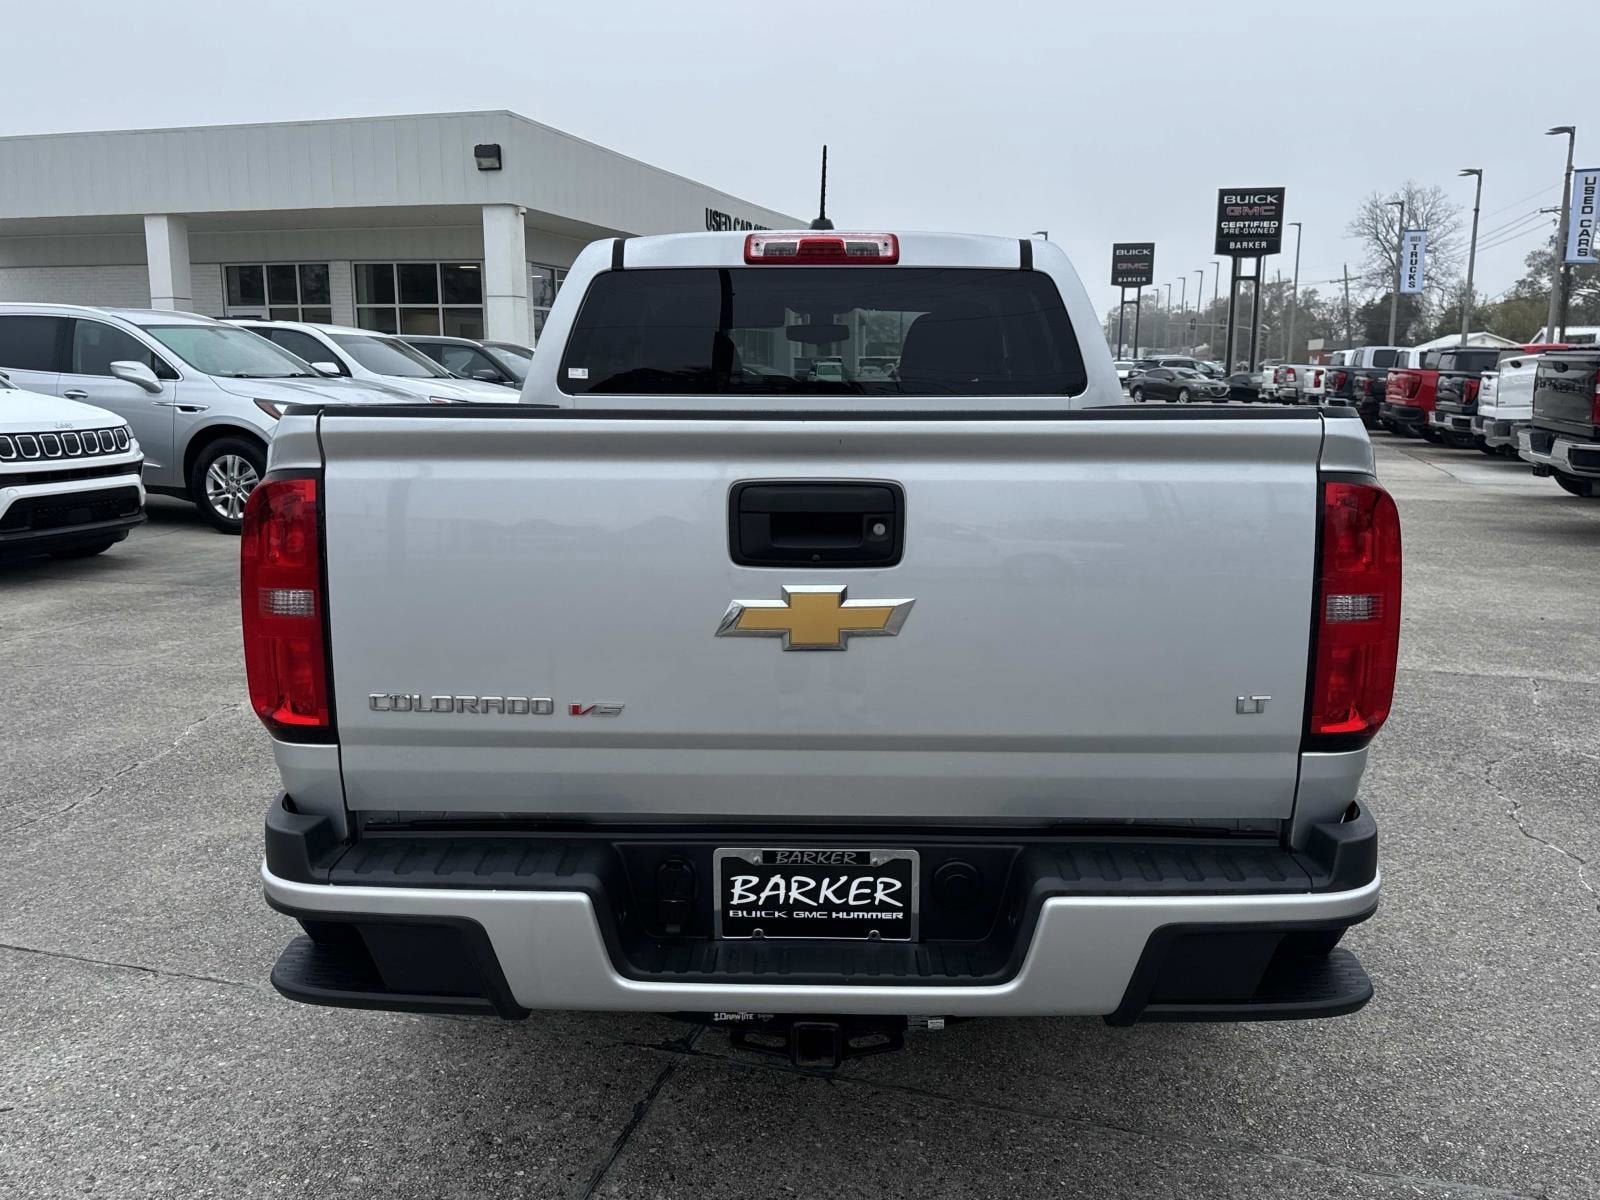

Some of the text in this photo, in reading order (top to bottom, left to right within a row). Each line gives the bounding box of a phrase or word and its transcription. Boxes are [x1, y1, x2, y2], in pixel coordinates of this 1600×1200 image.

[1223, 194, 1279, 204] BUICK
[1226, 205, 1276, 216] GMC
[1577, 176, 1597, 257] USED CARS
[705, 207, 732, 231] USED
[1221, 220, 1279, 228] CERTIFIED
[1229, 241, 1267, 249] BARKER
[1117, 262, 1149, 270] GMC
[1408, 243, 1418, 288] TRUCKS
[368, 692, 625, 718] COLORADO V6
[1236, 695, 1272, 714] LT
[775, 851, 857, 865] BARKER
[730, 874, 904, 907] BARKER
[729, 909, 904, 920] BUICK GMC HUMMER
